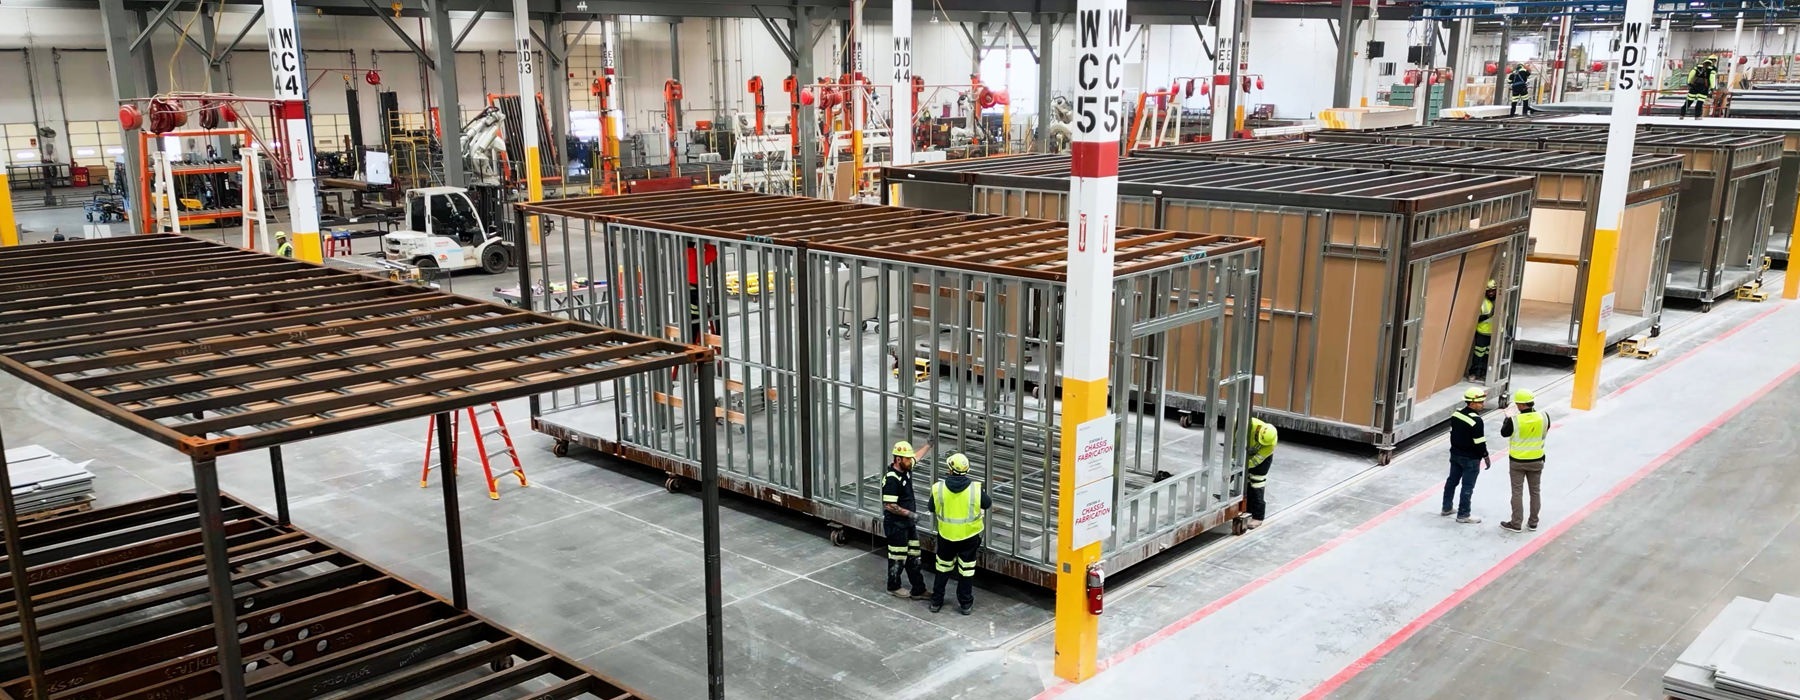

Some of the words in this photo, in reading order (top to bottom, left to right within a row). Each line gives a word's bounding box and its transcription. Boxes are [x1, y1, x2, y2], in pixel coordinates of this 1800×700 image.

[268, 28, 281, 95] WC4
[279, 28, 298, 95] WC4
[522, 39, 531, 74] WD3
[1077, 9, 1101, 133] WC5
[1104, 9, 1123, 132] WC5
[1218, 38, 1226, 73] WE4
[1619, 22, 1641, 90] WD5
[1077, 445, 1113, 462] FABRICATION
[1085, 440, 1107, 452] CHASSIS
[1075, 508, 1111, 525] FABRICATION
[1082, 502, 1105, 515] CHASSIS
